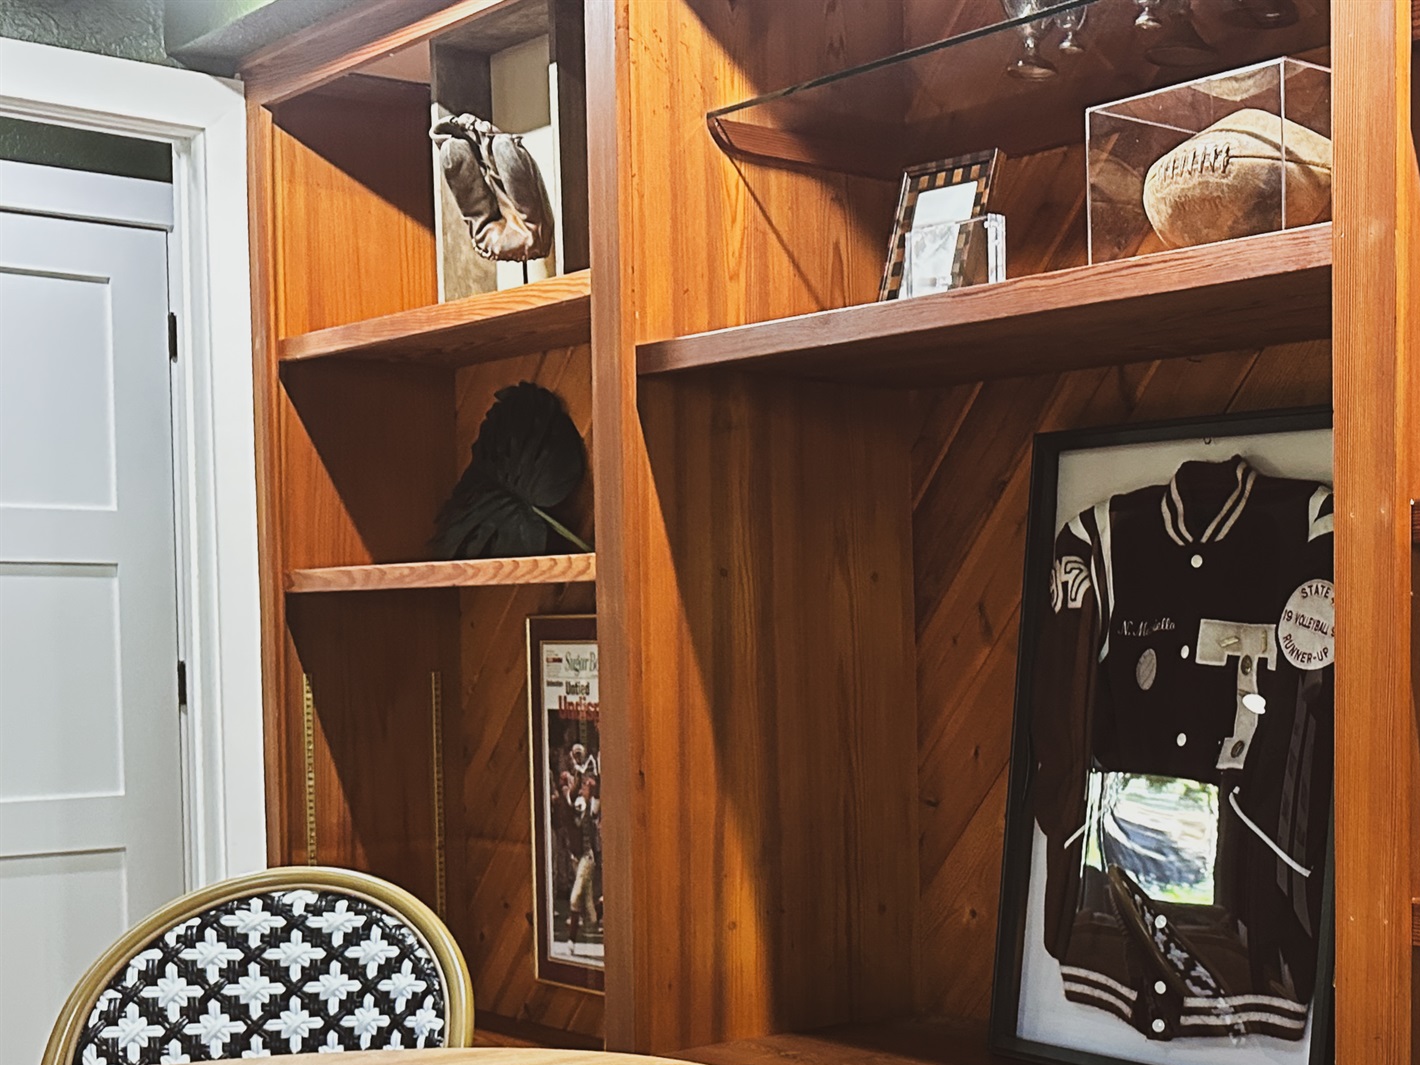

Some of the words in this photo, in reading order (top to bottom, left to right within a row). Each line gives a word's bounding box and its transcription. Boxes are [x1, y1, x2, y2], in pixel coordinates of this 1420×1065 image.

[1300, 584, 1331, 600] STATE
[1295, 612, 1329, 636] VOLLEYBALL
[1282, 633, 1329, 664] RUNNER-UP
